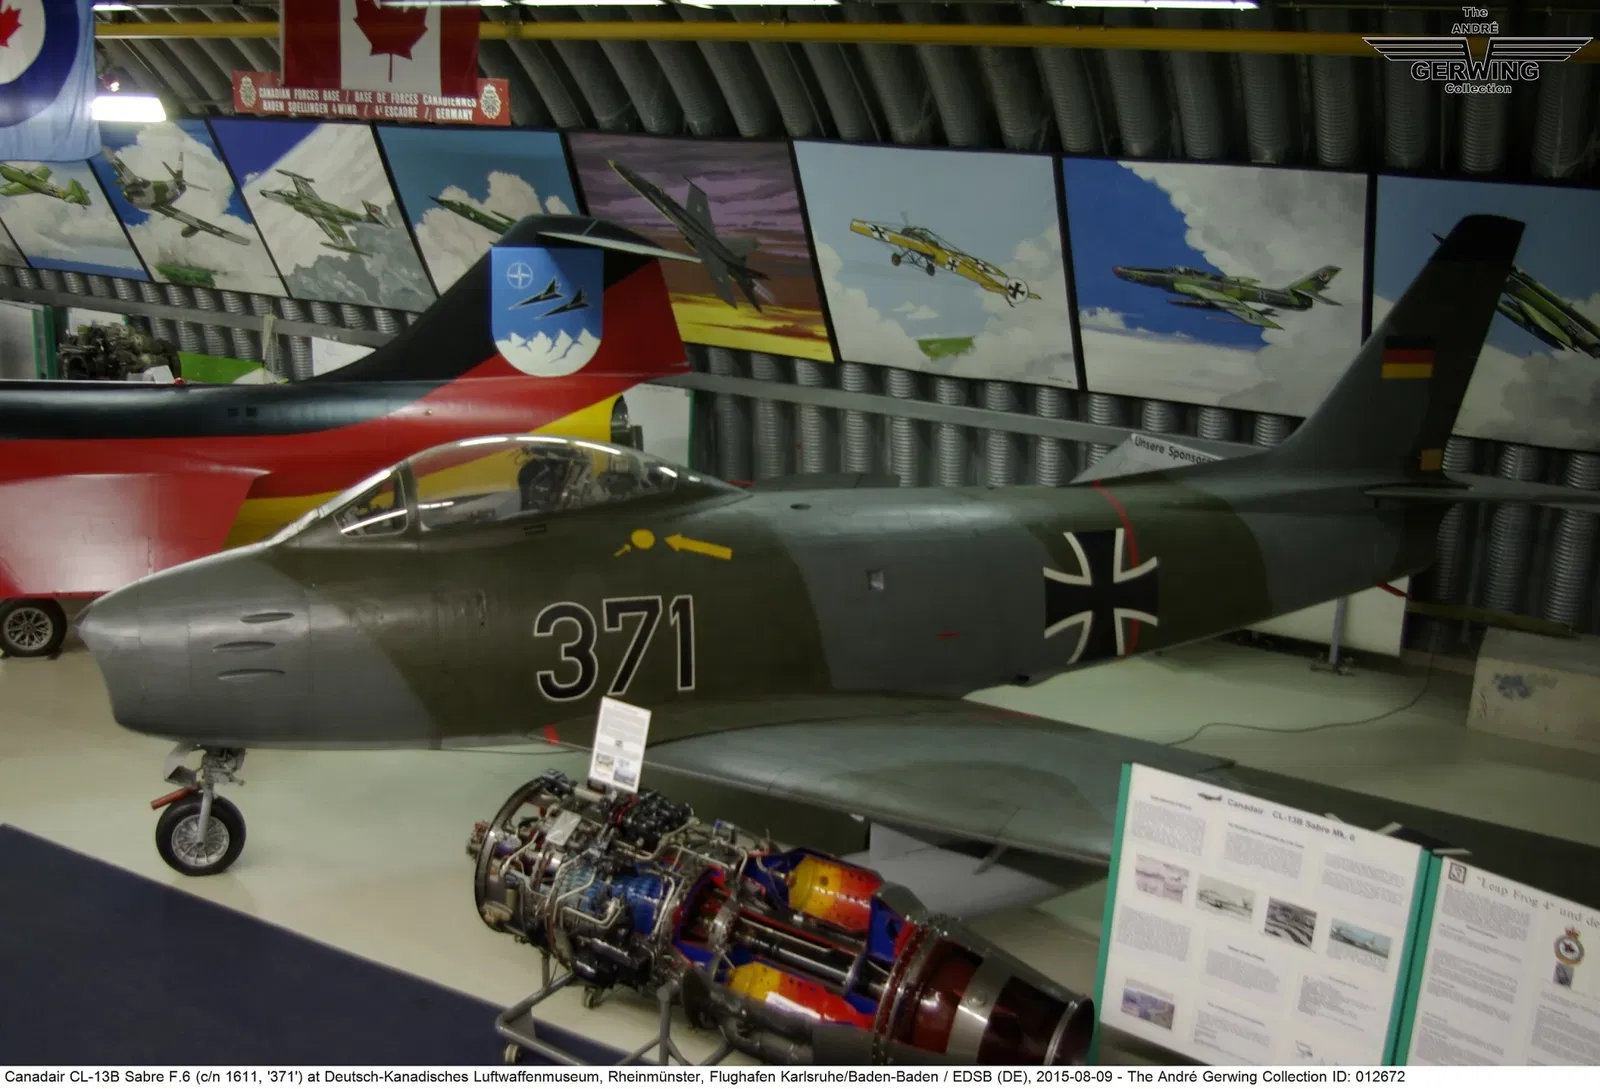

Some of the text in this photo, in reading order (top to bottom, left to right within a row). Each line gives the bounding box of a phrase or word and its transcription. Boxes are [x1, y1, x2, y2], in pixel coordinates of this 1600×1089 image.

[258, 87, 291, 100] CANADIAN
[294, 88, 320, 101] FORCES
[322, 89, 341, 102] BASE
[354, 91, 373, 103] BASE
[376, 92, 387, 104] DE
[390, 92, 419, 105] FORCES
[262, 100, 285, 112] BADEN
[435, 108, 473, 121] GERMANY
[1134, 435, 1216, 465] Unsere Sponsor
[533, 594, 696, 702] 371
[1227, 799, 1265, 815] Canadair
[1305, 819, 1331, 835] Sabre
[1513, 887, 1540, 909] Frog
[1559, 907, 1583, 922] und
